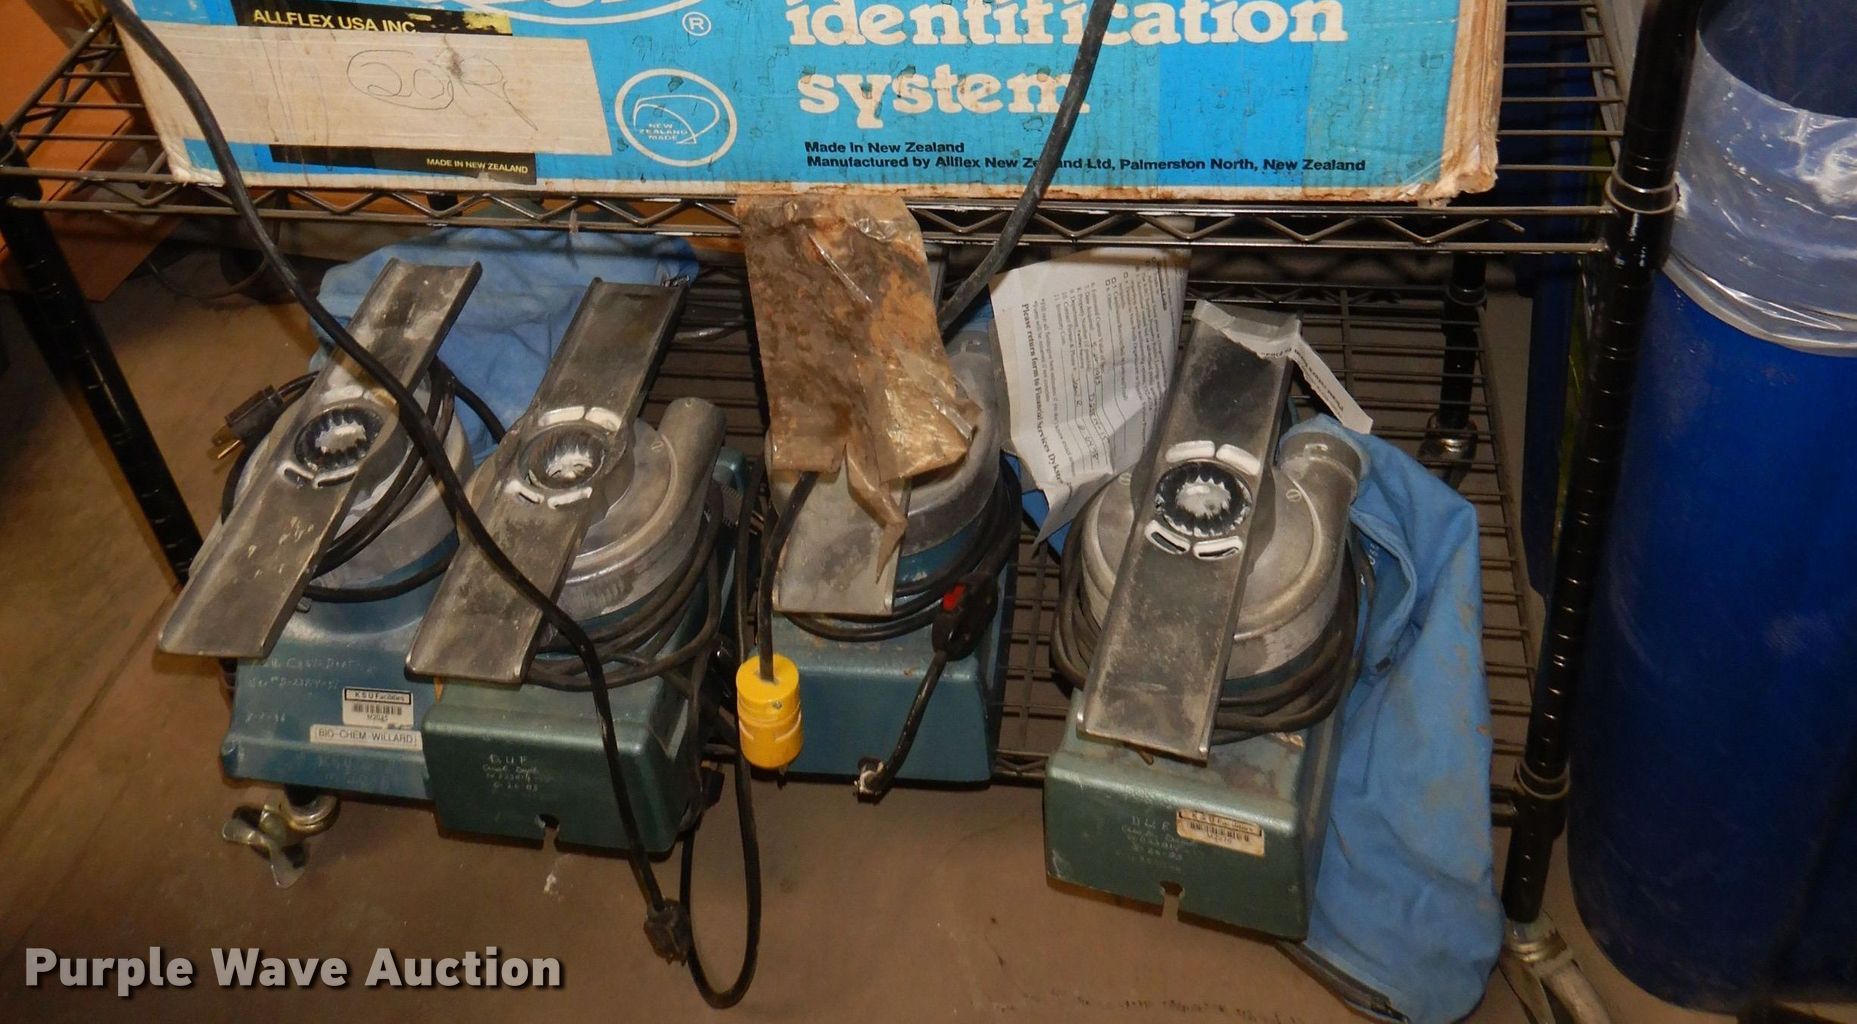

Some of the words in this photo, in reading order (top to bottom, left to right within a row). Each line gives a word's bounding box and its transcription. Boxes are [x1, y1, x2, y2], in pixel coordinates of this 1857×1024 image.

[253, 9, 335, 28] ALLFLEX
[338, 16, 379, 32] USA
[797, 63, 1090, 130] system
[804, 141, 846, 153] Made
[868, 142, 901, 154] New
[905, 142, 965, 153] Zealand
[426, 158, 452, 167] MADE
[454, 160, 464, 168] IN
[465, 161, 486, 169] NEW
[487, 162, 529, 174] ZEALAND
[807, 156, 909, 168] Manufactured
[913, 156, 930, 169] by
[935, 156, 981, 168] Allflex
[985, 157, 1018, 169] New
[1022, 157, 1083, 169] Zeand
[1087, 158, 1116, 170] Ltd,
[1120, 158, 1206, 170] Palmerston
[1210, 158, 1258, 172] North,
[1263, 159, 1298, 171] New
[1302, 159, 1366, 171] Zealand
[1021, 303, 1032, 328] Please
[1028, 331, 1036, 356] return
[1031, 357, 1040, 377] form
[1034, 378, 1041, 386] to
